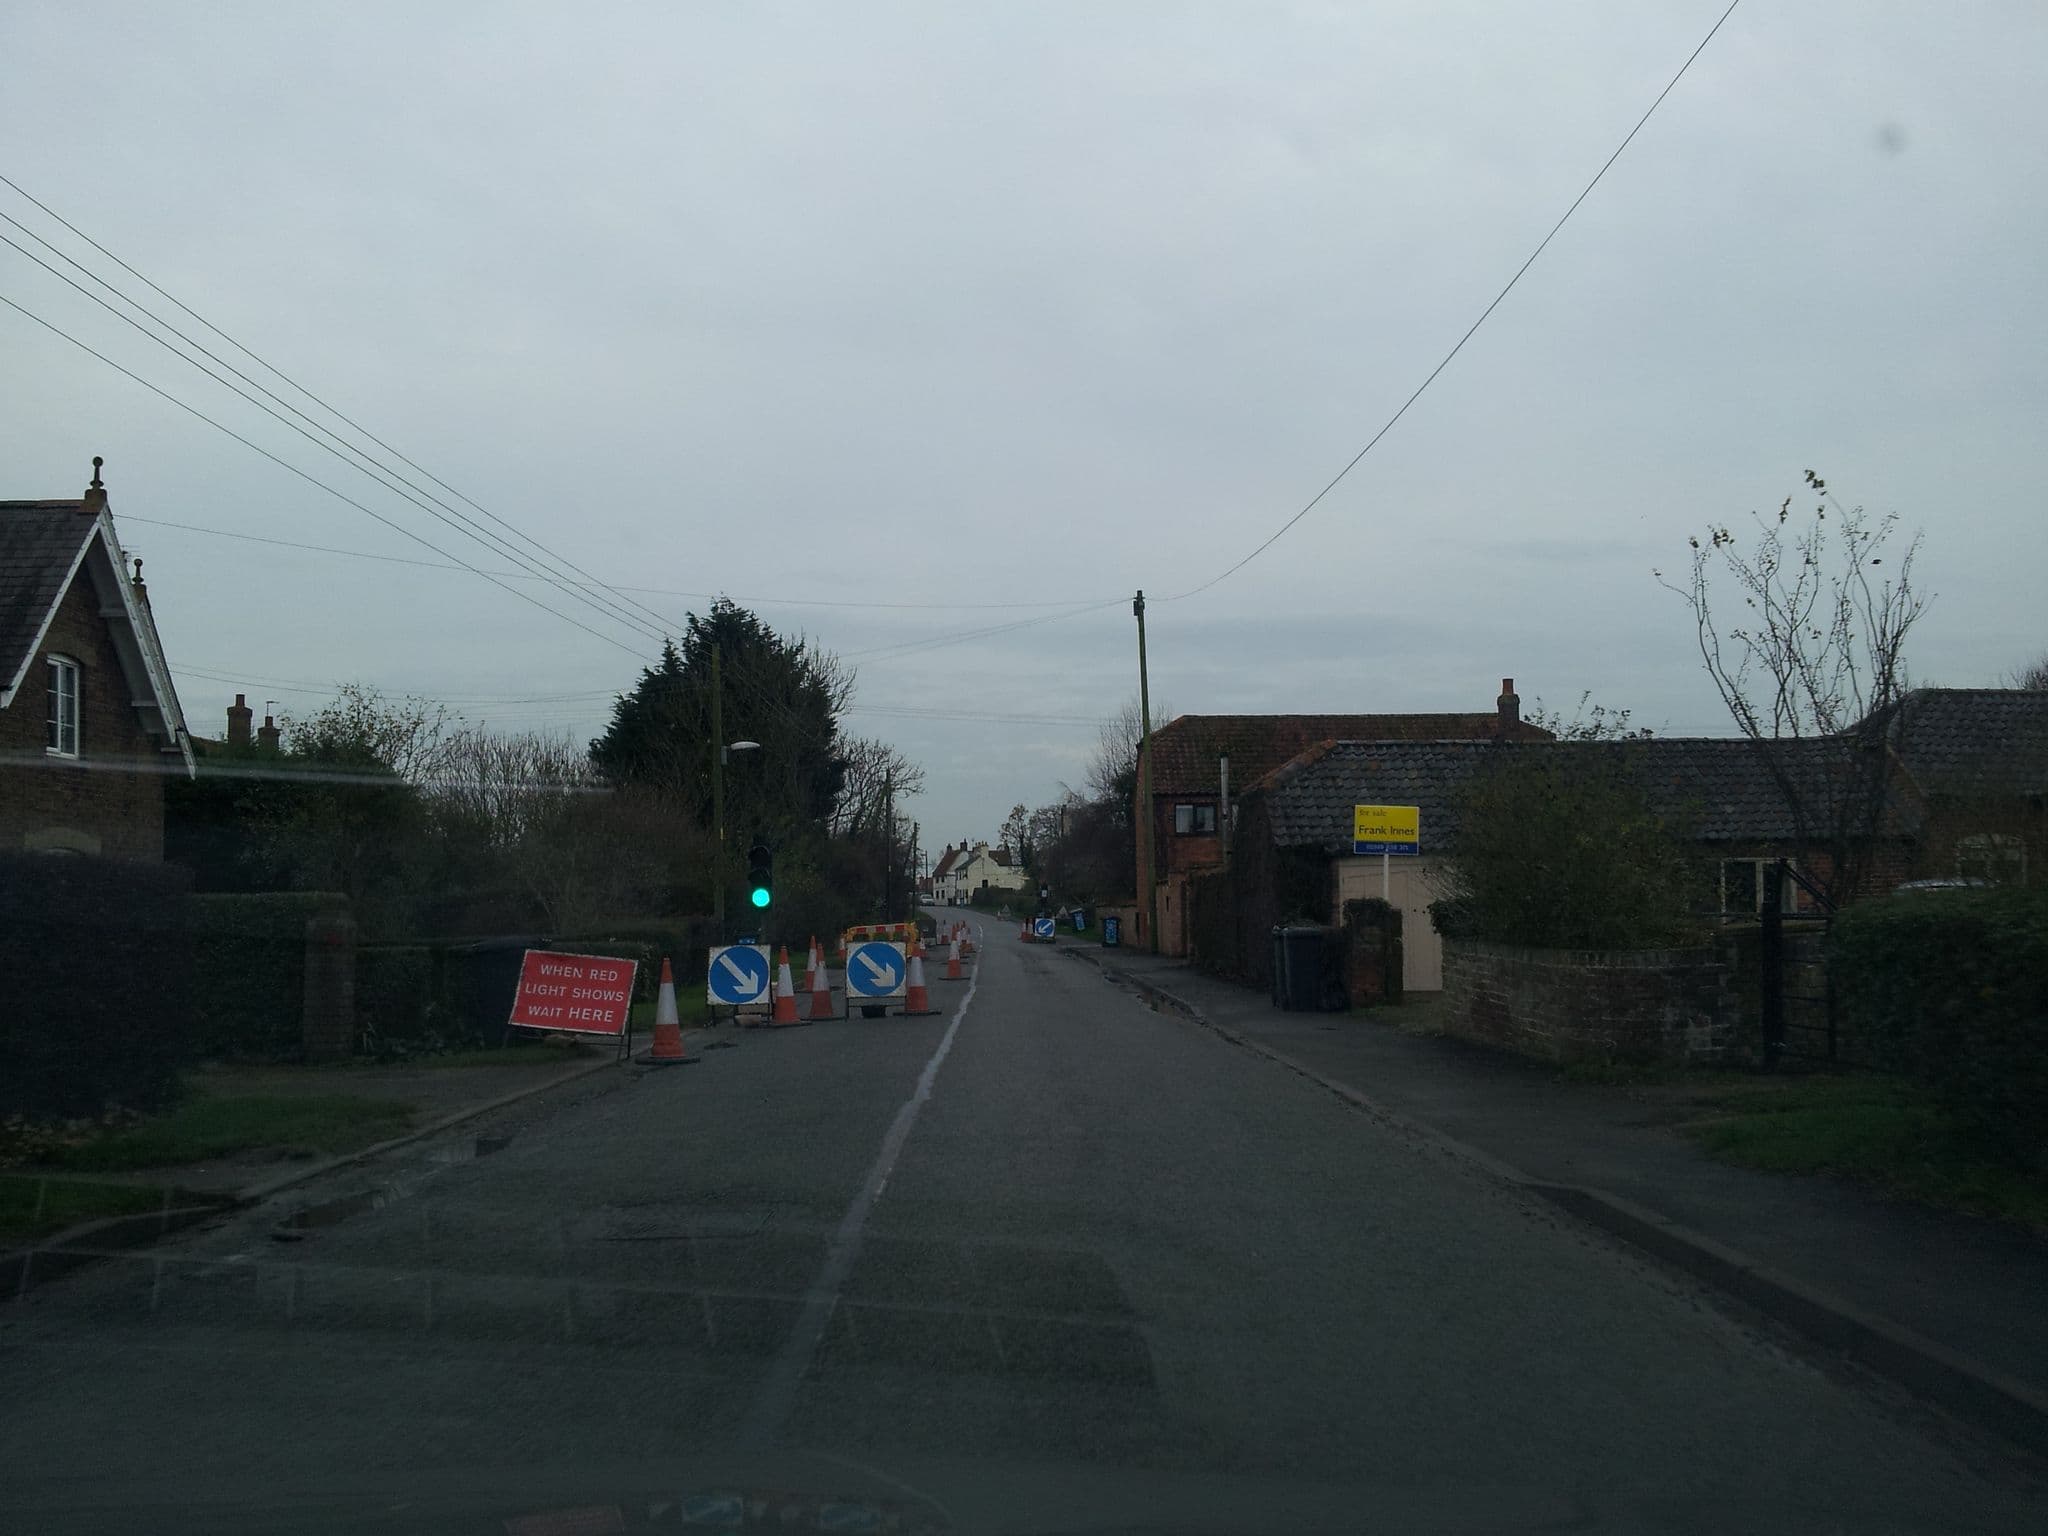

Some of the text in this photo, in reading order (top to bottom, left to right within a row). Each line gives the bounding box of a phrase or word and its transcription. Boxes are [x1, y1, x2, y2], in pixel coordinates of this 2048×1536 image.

[1359, 825, 1415, 835] Frank Innes
[540, 964, 618, 981] WHEN RED
[525, 983, 624, 1001] LIGHT SHOWS
[528, 1006, 615, 1022] WAIT HERE
